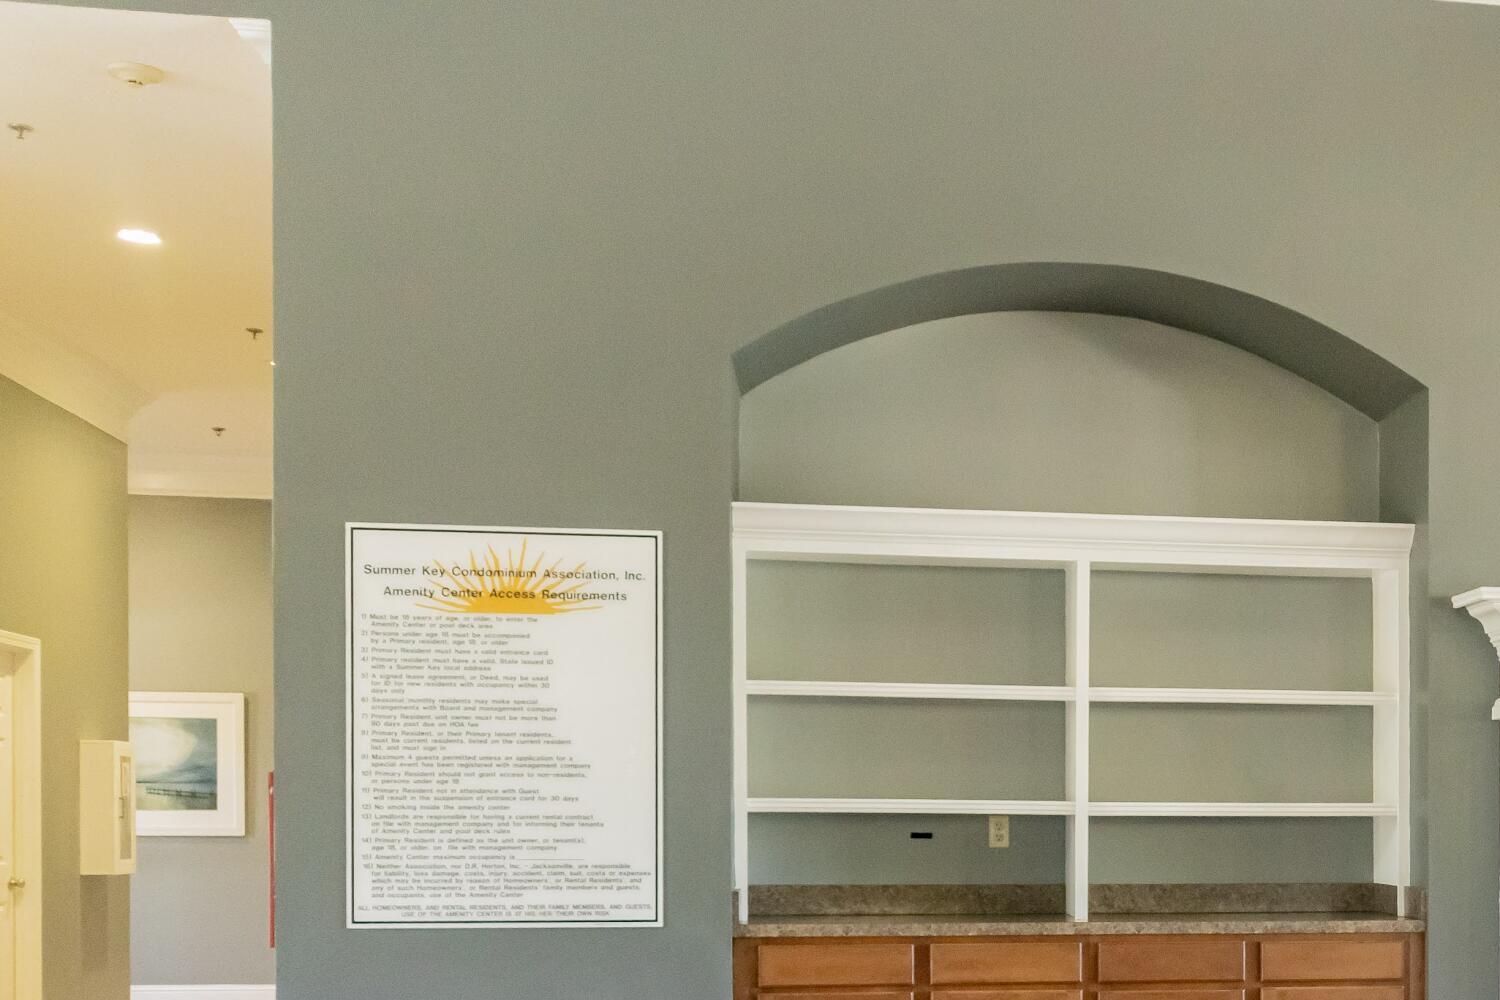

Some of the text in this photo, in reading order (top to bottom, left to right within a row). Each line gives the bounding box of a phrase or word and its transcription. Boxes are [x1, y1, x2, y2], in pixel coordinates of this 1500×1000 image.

[363, 563, 646, 582] Summer Key Condominium Association, Inc.
[383, 585, 628, 602] Amenity Center Access Requirements
